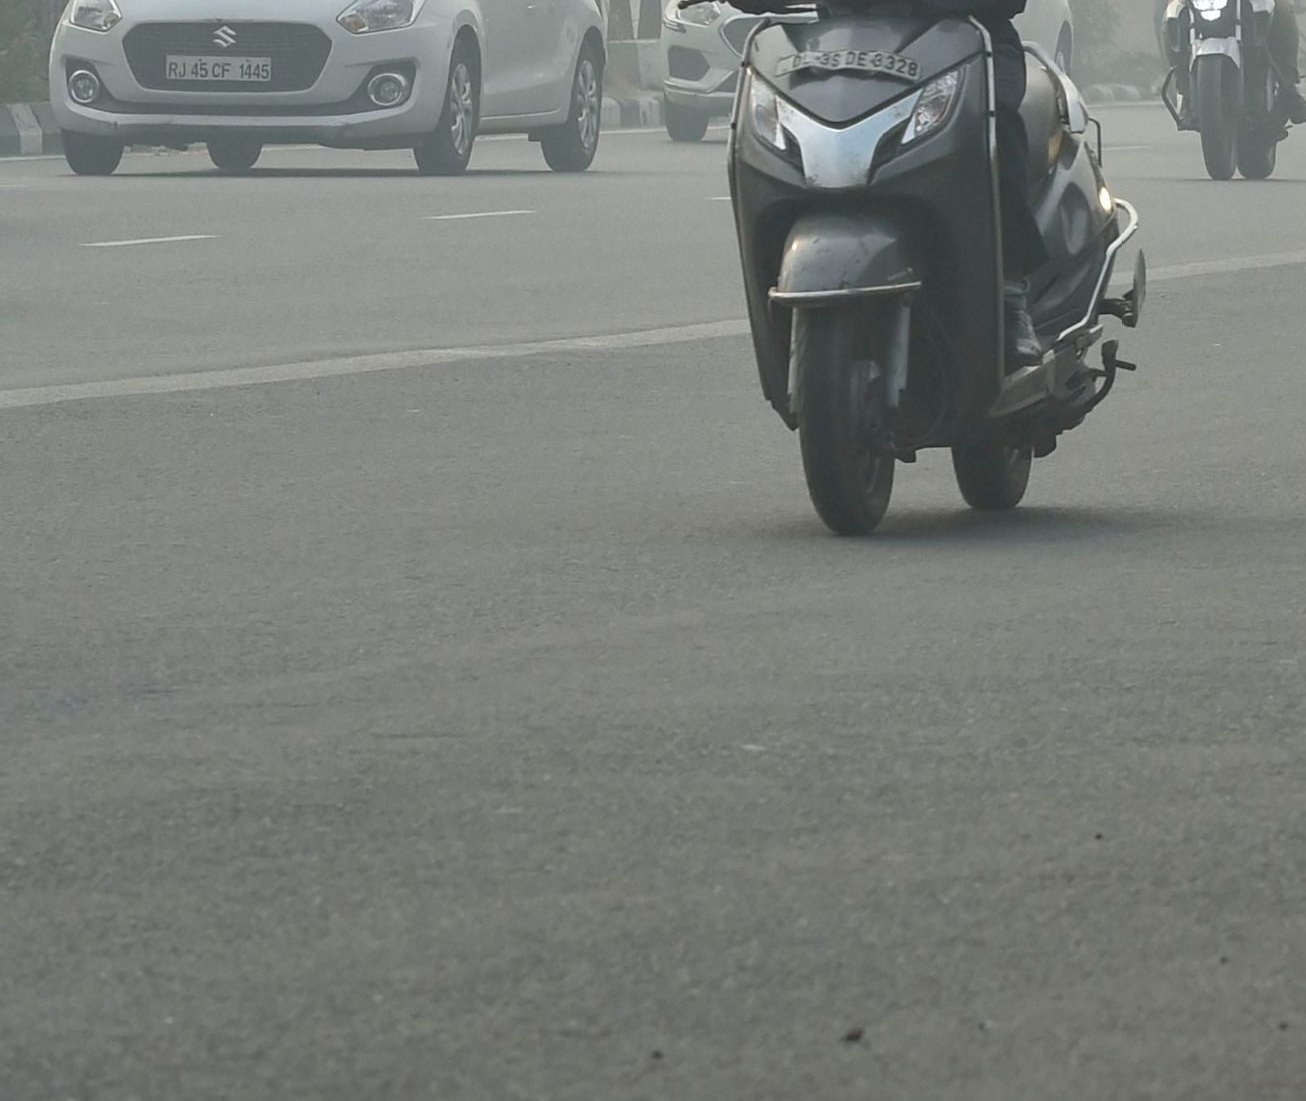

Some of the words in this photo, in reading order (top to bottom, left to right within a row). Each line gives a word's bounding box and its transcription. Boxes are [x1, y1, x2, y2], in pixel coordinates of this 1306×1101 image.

[168, 62, 186, 77] RJ
[191, 62, 208, 78] 45
[211, 63, 231, 78] CF
[239, 63, 269, 79] 1445
